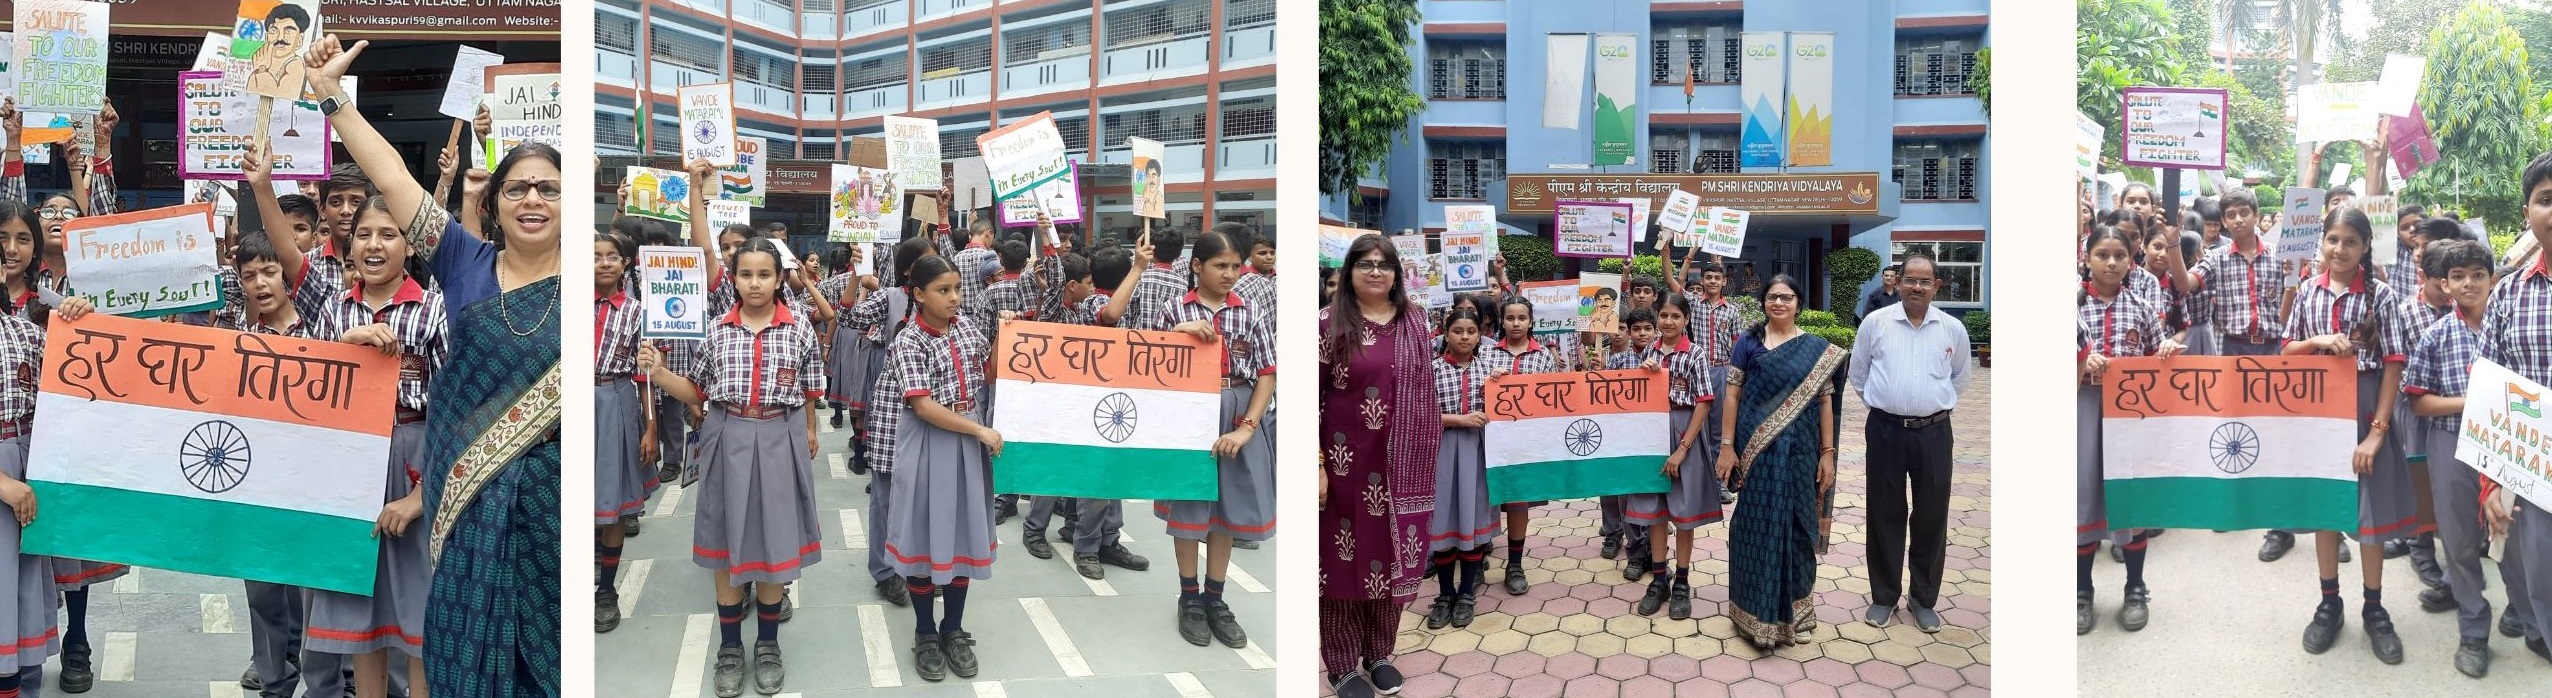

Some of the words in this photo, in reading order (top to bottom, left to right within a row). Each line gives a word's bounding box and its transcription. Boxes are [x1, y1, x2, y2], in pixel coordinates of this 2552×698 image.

[25, 9, 87, 34] SALUTE
[28, 36, 54, 56] TO
[62, 37, 98, 57] OUR
[114, 41, 147, 54] SHRI
[23, 58, 107, 84] FREEDOM
[19, 82, 105, 107] FIGHTERS
[504, 86, 534, 105] JAI
[691, 94, 718, 107] VANDE
[193, 101, 221, 116] TO
[523, 103, 561, 121] HIND
[684, 107, 724, 121] MATARAM!
[2133, 108, 2152, 120] TO
[189, 118, 226, 133] OUR
[892, 123, 928, 140] SALUTE
[2130, 121, 2155, 133] OUR
[186, 135, 254, 150] FREEDO
[737, 140, 758, 154] OUD
[988, 135, 1035, 160] Freedom
[1037, 130, 1050, 142] is
[2128, 133, 2186, 147] FREEDOM
[687, 149, 695, 160] 15
[696, 145, 726, 158] AUGUST
[893, 140, 910, 154] TO
[913, 140, 936, 155] OUR
[2139, 148, 2201, 161] FIGHTER
[203, 154, 295, 169] FIGER
[776, 168, 819, 179] विद्यालय
[997, 180, 1009, 194] in
[1011, 170, 1035, 188] Every
[1547, 179, 1575, 196] पीएम
[1579, 178, 1592, 193] श्री
[1595, 179, 1632, 195] केन्द्रीय
[1701, 181, 1716, 192] PM
[1718, 181, 1740, 192] SHRI
[1742, 180, 1789, 192] KENDRIYA
[1790, 180, 1843, 191] VIDYALAYA
[1013, 208, 1064, 220] FIGER
[1452, 211, 1485, 222] SALUTE
[1563, 216, 1577, 224] TO
[2291, 214, 2320, 226] VANDE
[843, 220, 867, 230] PROUD
[869, 221, 879, 231] TO
[1560, 225, 1579, 233] OUR
[1713, 223, 1738, 235] VANDE
[79, 228, 166, 260] Freedom
[176, 230, 198, 251] is
[1446, 238, 1458, 246] JAI
[1461, 236, 1482, 246] HIND!
[1558, 233, 1602, 243] FREEDOM
[1707, 232, 1741, 246] MATARAM!
[1456, 246, 1470, 254] JAI
[1567, 243, 1613, 252] FIGHTER
[647, 256, 665, 267] JAI
[668, 256, 699, 268] HIND!
[1447, 254, 1482, 264] BHARAT!
[664, 269, 683, 281] JAI
[651, 282, 699, 295] BHARAT!
[1459, 279, 1482, 287] AUGUST
[105, 288, 150, 311] Every
[1527, 289, 1571, 304] Freedom
[653, 320, 662, 329] 15
[664, 321, 697, 330] AUGUST
[1539, 317, 1563, 330] Every
[1008, 332, 1056, 384] हर
[1060, 336, 1116, 383] घर
[1126, 329, 1196, 387] तिरंगा
[59, 328, 129, 402] हर
[136, 337, 216, 405] घर
[234, 333, 361, 421] तिरंगा
[2115, 369, 2168, 419] हर
[2169, 368, 2223, 412] घर
[2236, 356, 2329, 414] तिरंगा
[1494, 383, 1533, 422] हर
[1534, 381, 1576, 413] घर
[1585, 372, 1650, 411] तिरंगा
[2490, 408, 2552, 455] VANDE
[2497, 463, 2535, 498] August
